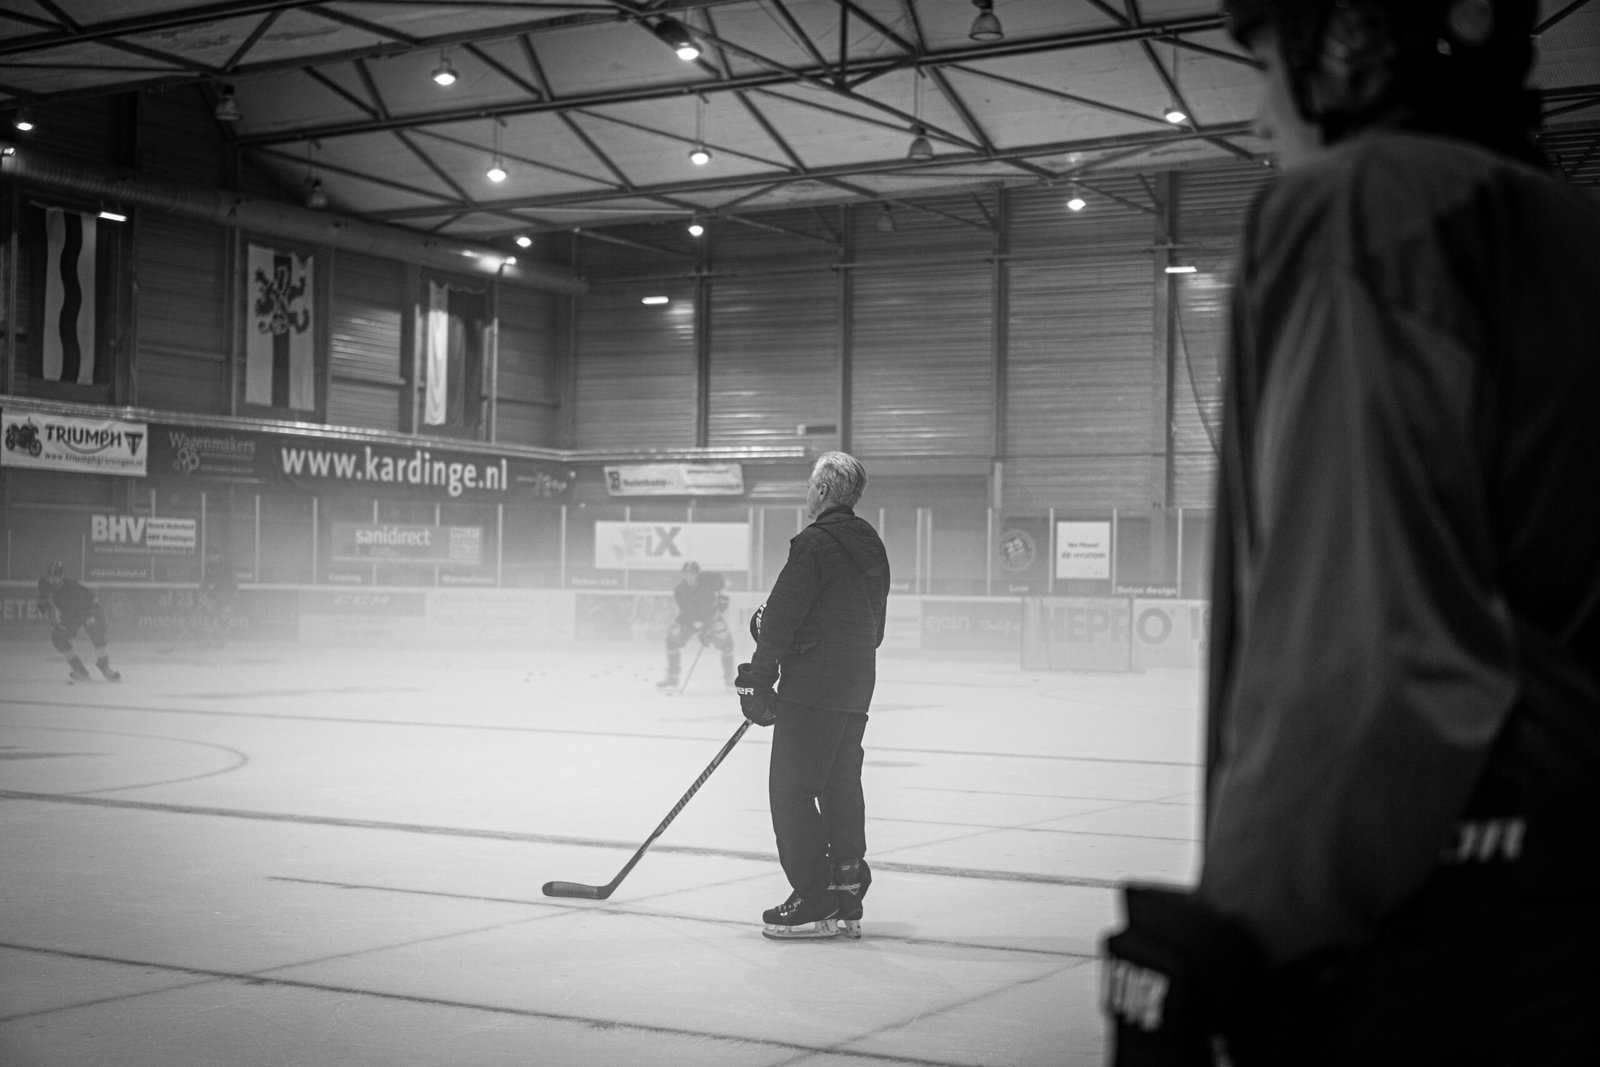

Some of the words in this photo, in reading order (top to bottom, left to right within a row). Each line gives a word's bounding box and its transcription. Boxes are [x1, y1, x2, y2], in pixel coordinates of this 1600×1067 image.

[45, 424, 122, 449] TRIUMPH
[281, 446, 507, 498] www.kardinge.nl
[91, 515, 146, 544] BHV
[355, 525, 430, 547] sanidirect
